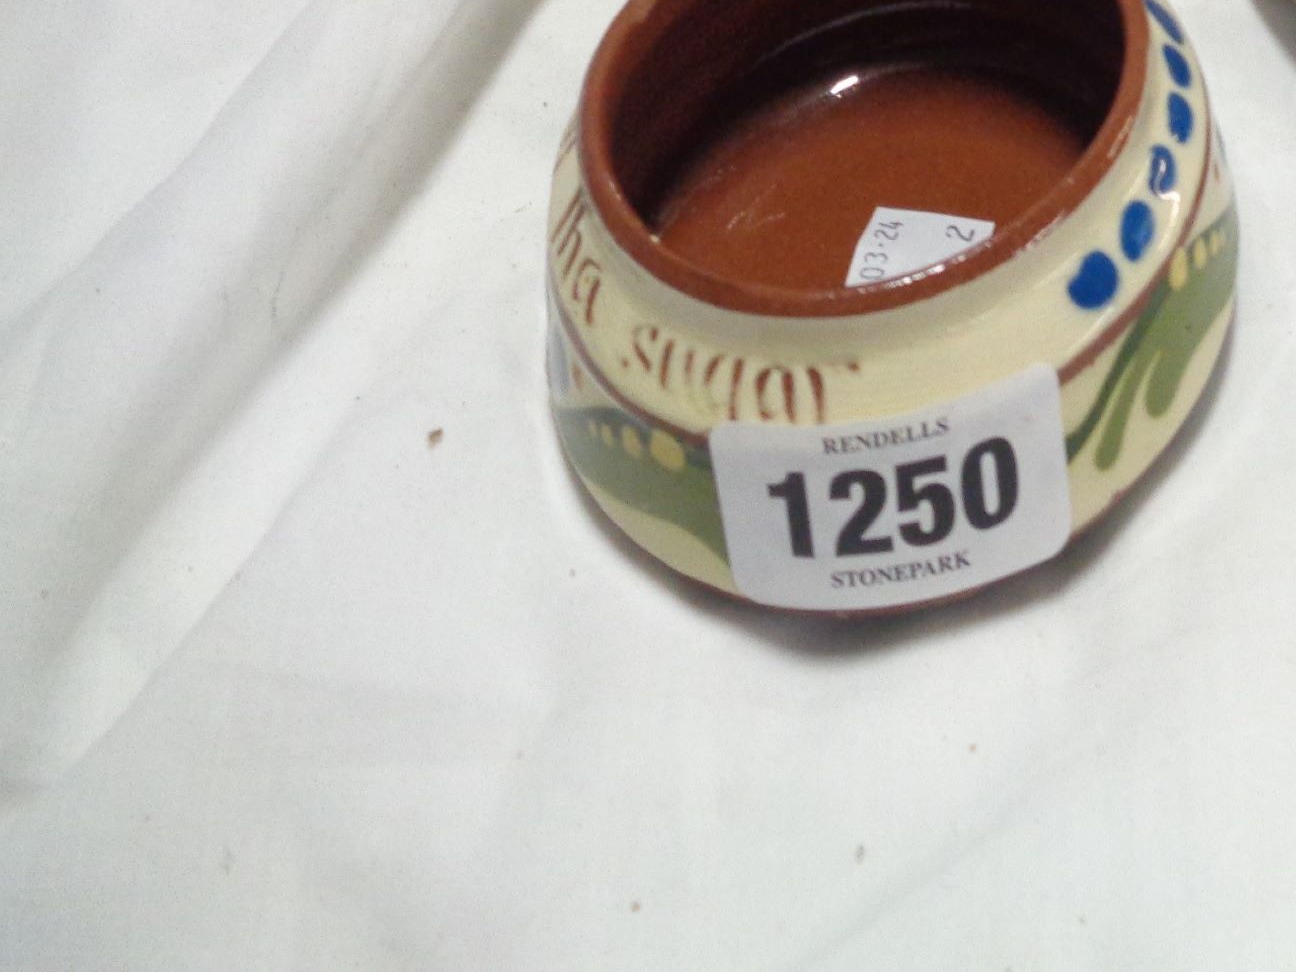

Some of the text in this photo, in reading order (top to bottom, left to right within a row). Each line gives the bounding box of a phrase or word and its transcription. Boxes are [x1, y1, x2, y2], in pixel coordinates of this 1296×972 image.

[945, 224, 975, 242] 2
[822, 415, 951, 456] RENDELLS
[767, 436, 1020, 559] 1250
[830, 550, 972, 590] STONEPARK
